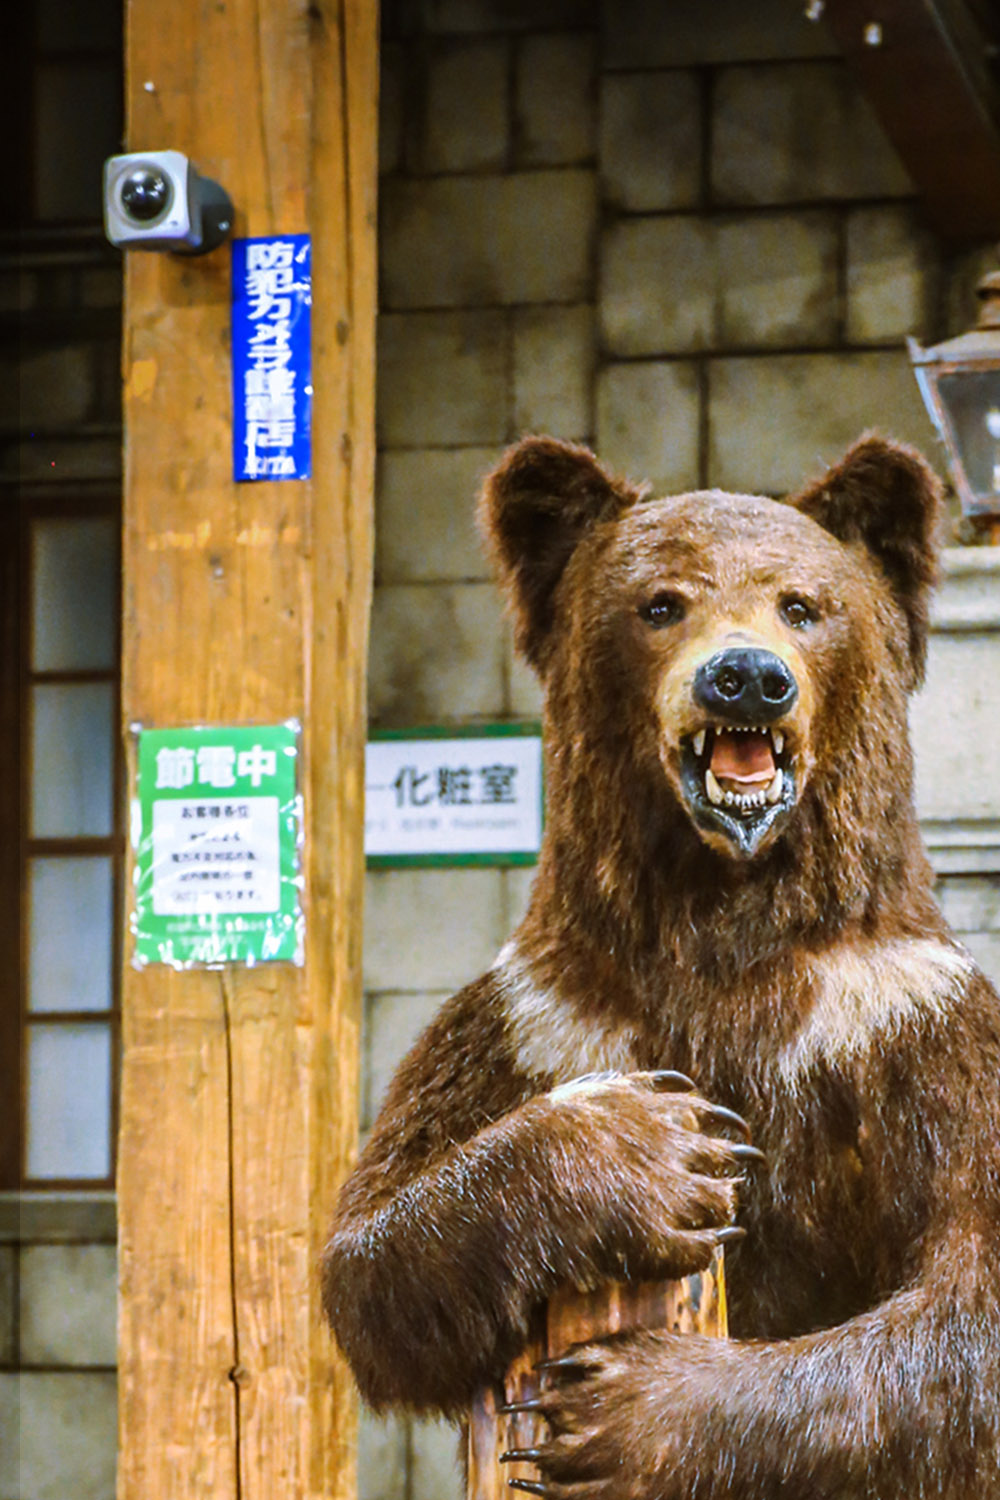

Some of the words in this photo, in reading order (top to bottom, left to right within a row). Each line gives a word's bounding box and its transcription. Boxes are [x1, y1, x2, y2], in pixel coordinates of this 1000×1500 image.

[155, 744, 277, 789] 節電中
[391, 763, 518, 807] 化粧室
